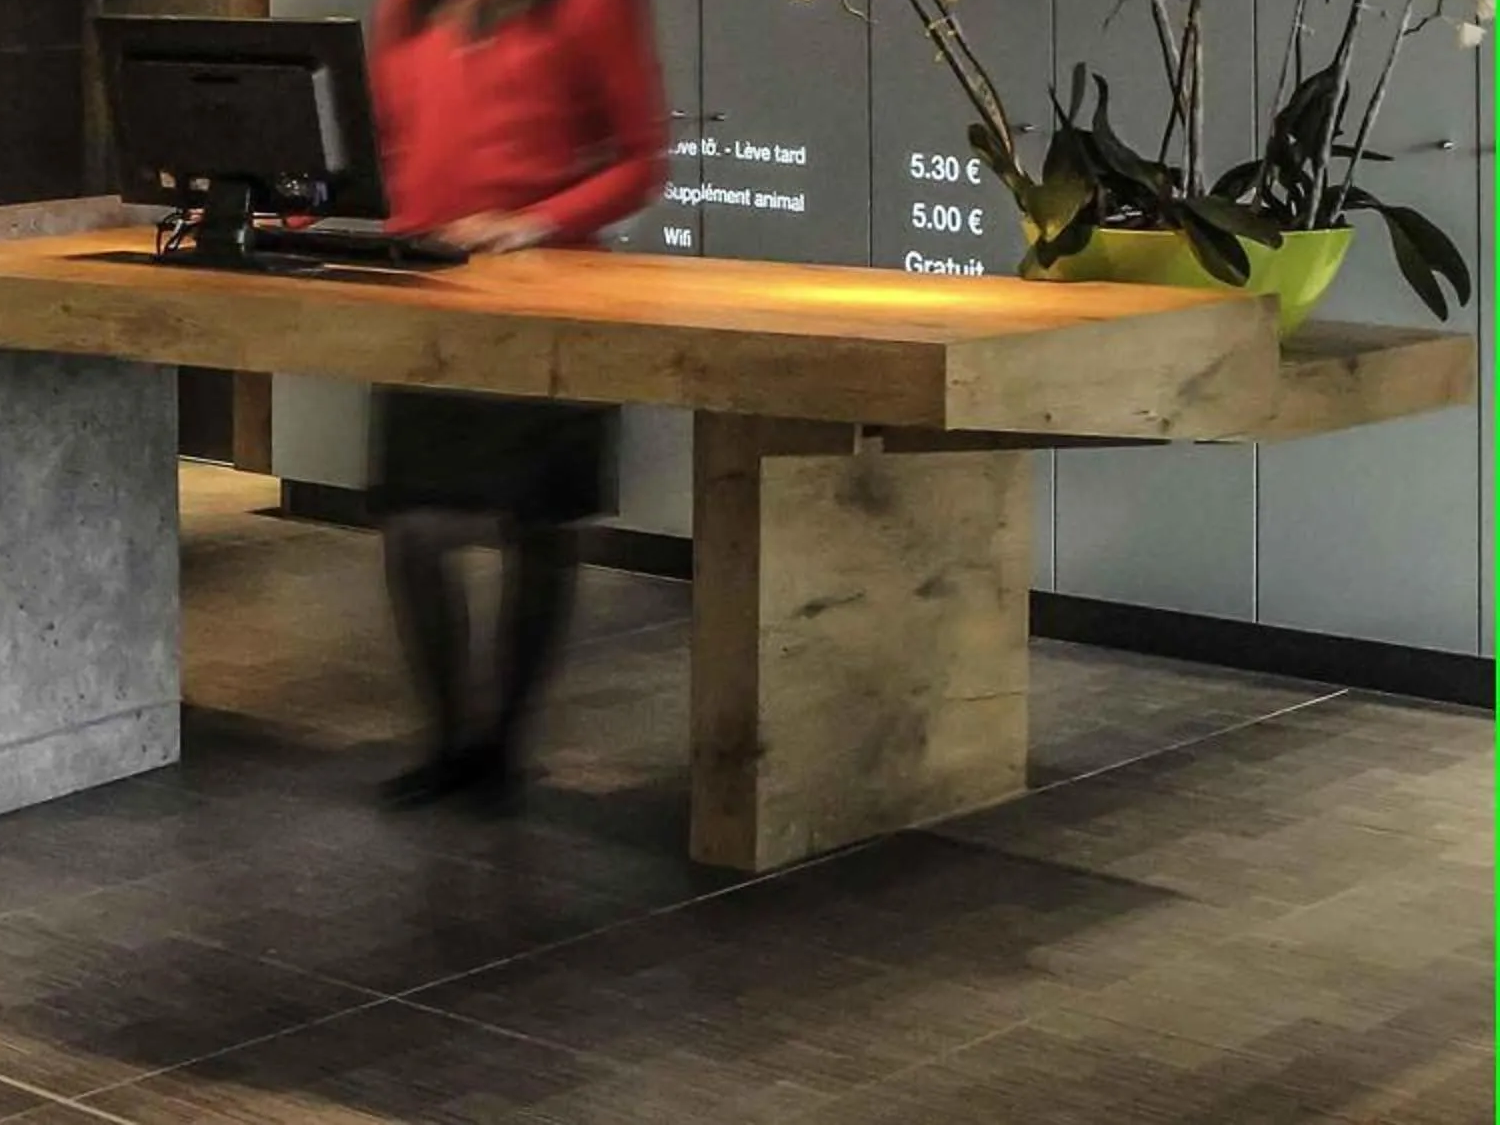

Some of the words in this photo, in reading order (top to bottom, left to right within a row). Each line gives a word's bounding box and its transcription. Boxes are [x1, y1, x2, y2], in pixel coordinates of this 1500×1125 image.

[734, 140, 772, 162] Lève
[774, 143, 807, 165] tard
[910, 152, 961, 182] 5.30
[965, 158, 982, 185] €
[663, 180, 751, 207] Supplément
[754, 190, 805, 212] animal
[911, 202, 962, 232] 5.00
[967, 208, 984, 236] €
[663, 225, 692, 248] Wifi
[904, 250, 985, 276] Gratuit
